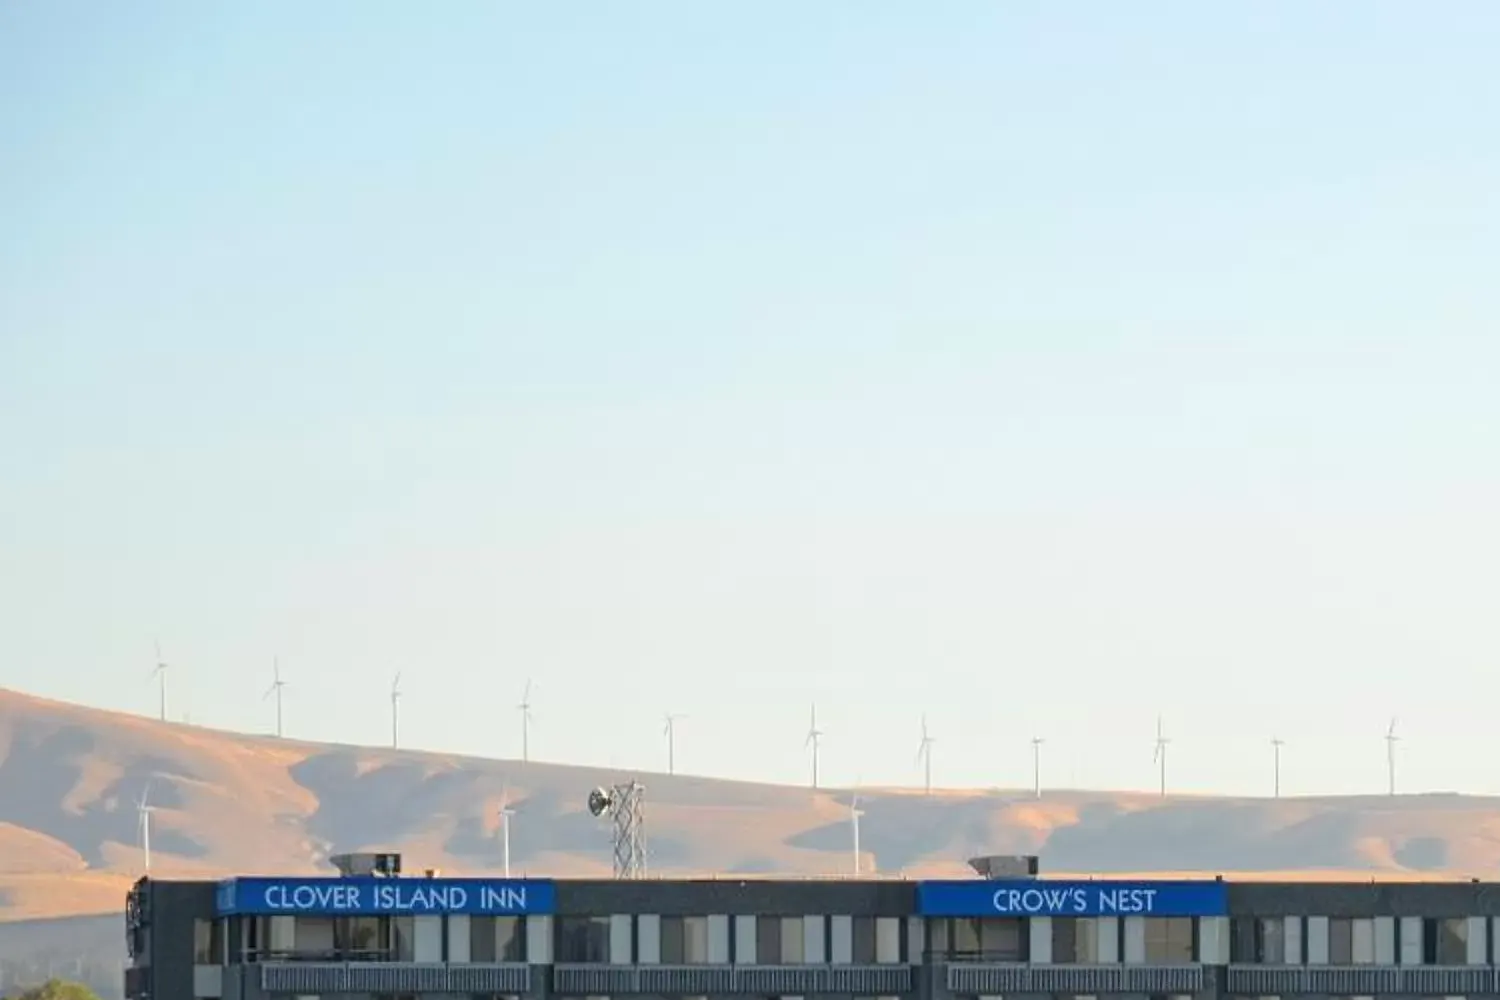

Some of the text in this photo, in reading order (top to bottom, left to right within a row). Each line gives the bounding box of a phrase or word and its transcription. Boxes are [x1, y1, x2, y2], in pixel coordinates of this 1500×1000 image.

[264, 885, 527, 910] CLOVER ISLAND INN
[993, 888, 1156, 912] CROW'S NEST
